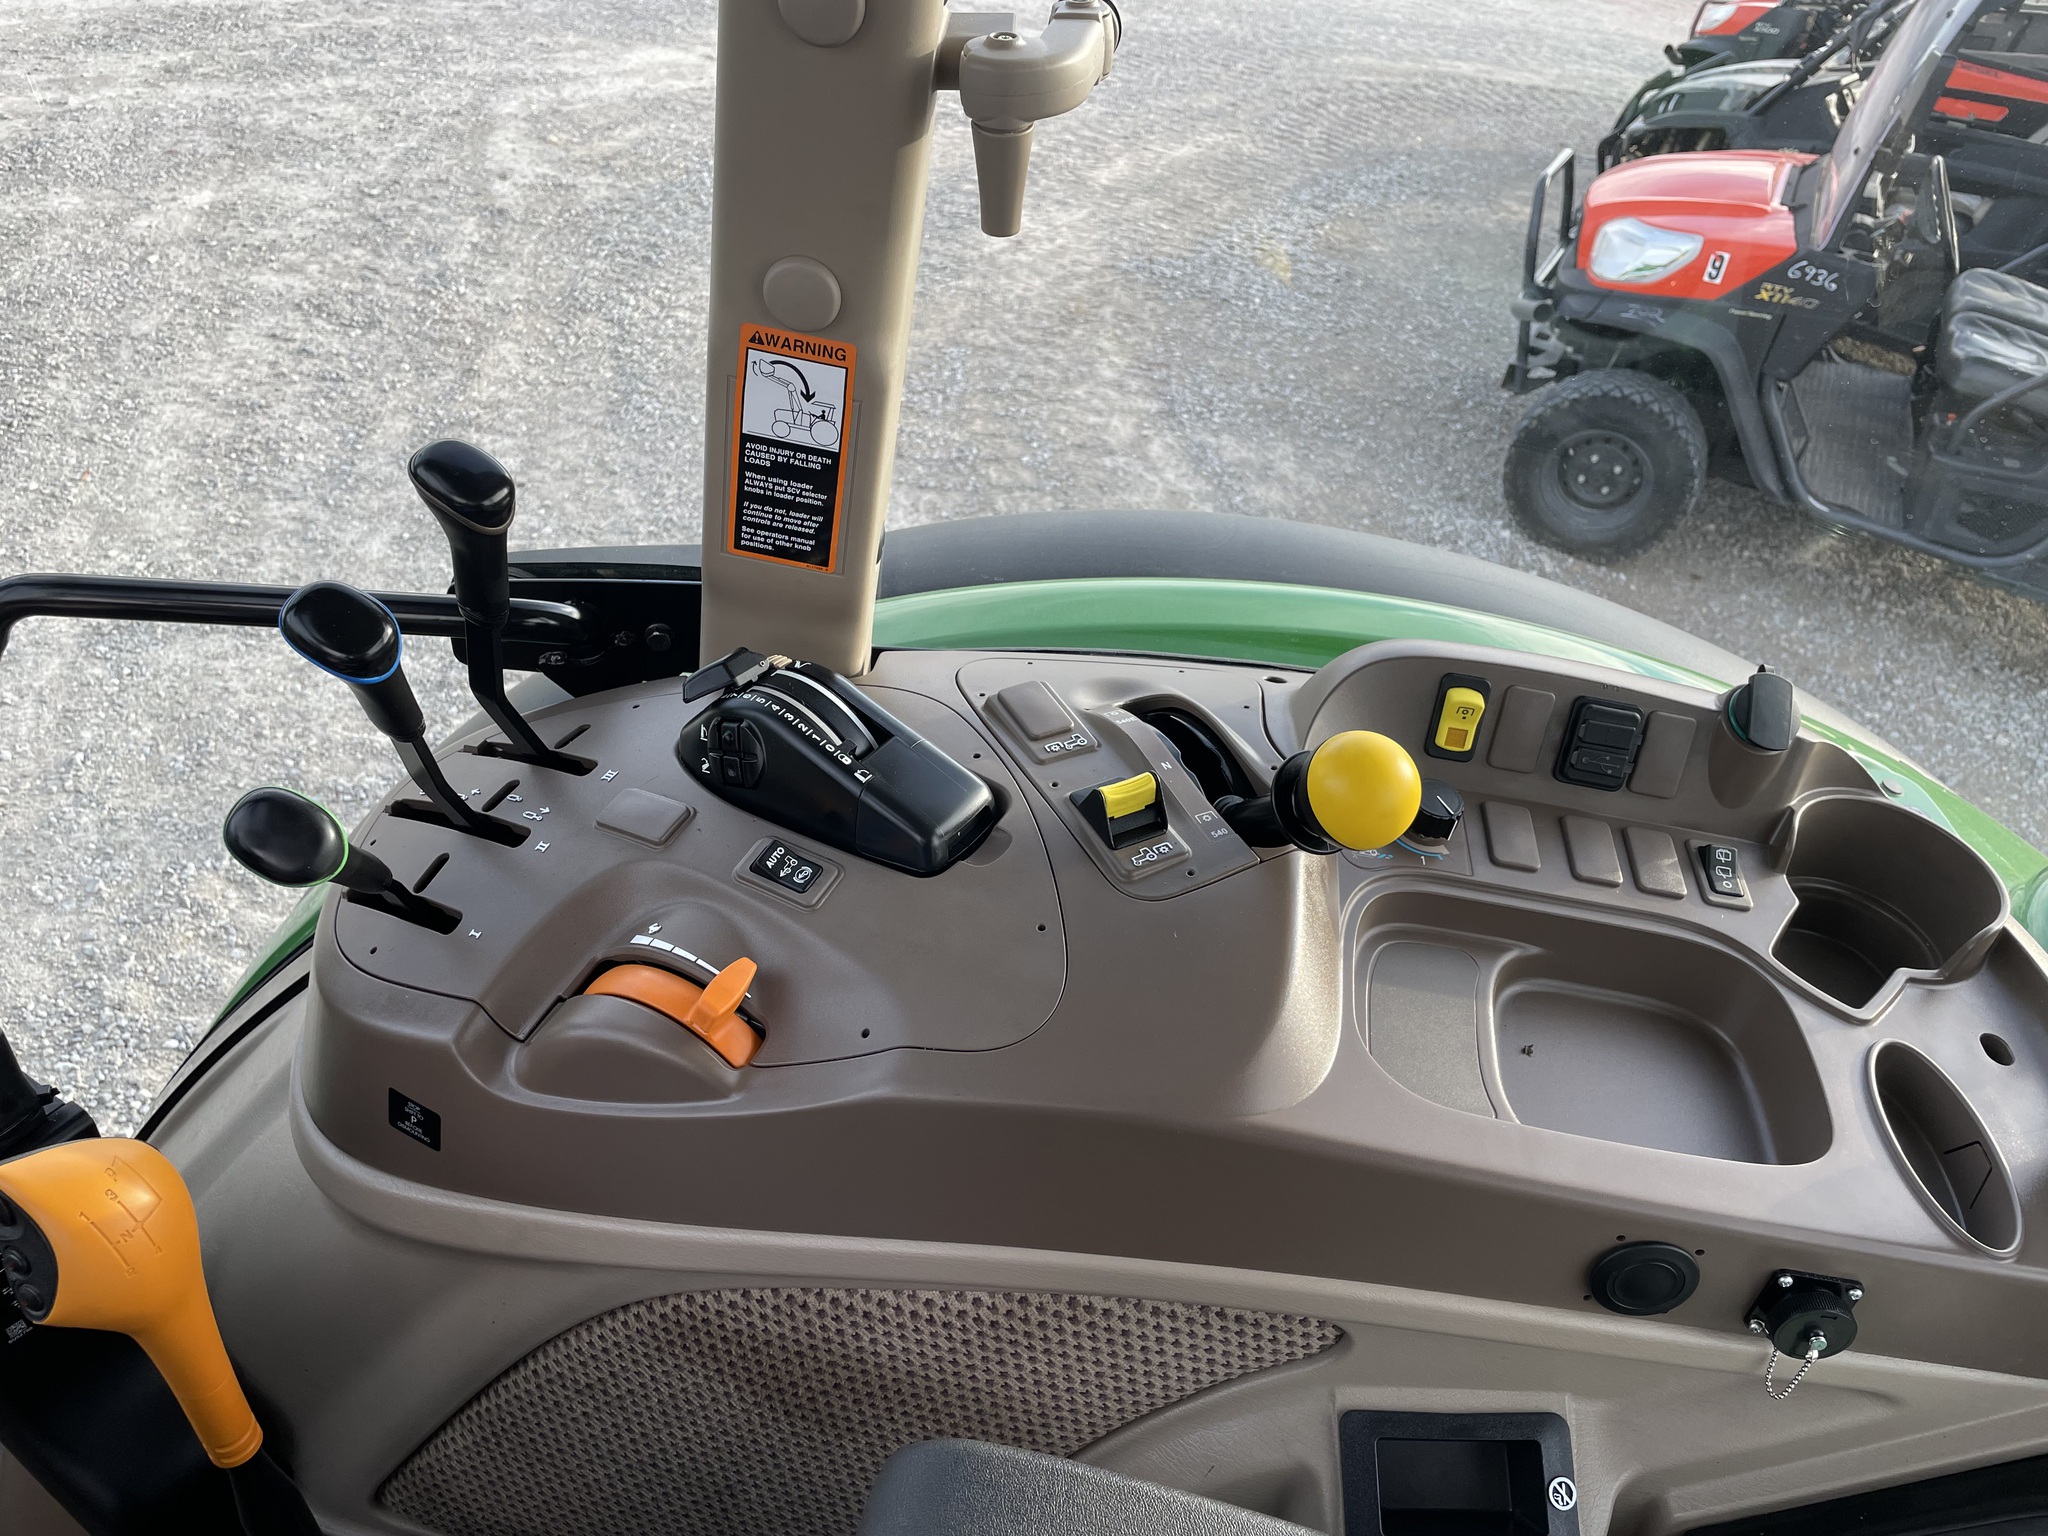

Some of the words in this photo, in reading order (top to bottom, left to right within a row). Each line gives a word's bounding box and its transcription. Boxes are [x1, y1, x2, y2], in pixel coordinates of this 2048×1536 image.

[1708, 254, 1725, 281] 9
[1787, 260, 1839, 292] 6936
[765, 333, 847, 362] WARNING
[744, 456, 771, 467] LOADS
[745, 442, 768, 452] AVOID
[769, 446, 794, 457] INJURY
[796, 452, 807, 460] OR
[808, 454, 832, 465] DEATH
[745, 449, 776, 460] CAUSED
[790, 458, 822, 470] FALLING
[744, 478, 773, 489] ALWAYS
[786, 486, 800, 494] SCV
[802, 490, 828, 500] selector
[745, 471, 766, 481] When
[768, 475, 788, 486] using
[790, 480, 814, 490] loader
[744, 485, 764, 495] knobs
[773, 491, 795, 500] loader
[795, 495, 824, 507] position.
[742, 515, 771, 526] controls
[784, 523, 816, 535] released.
[743, 508, 773, 519] continue
[782, 516, 802, 525] move
[802, 520, 820, 528] after
[788, 510, 811, 520] loader
[740, 539, 774, 551] positions.
[741, 525, 755, 534] See
[756, 529, 789, 541] operators
[790, 536, 816, 546] manual
[752, 535, 765, 543] use
[775, 539, 793, 548] other
[794, 542, 812, 552] knob
[784, 713, 795, 721] 3
[797, 722, 809, 732] 2
[1160, 761, 1173, 770] N
[1211, 827, 1228, 838] 540
[765, 846, 785, 869] AUTO
[119, 1229, 134, 1243] N
